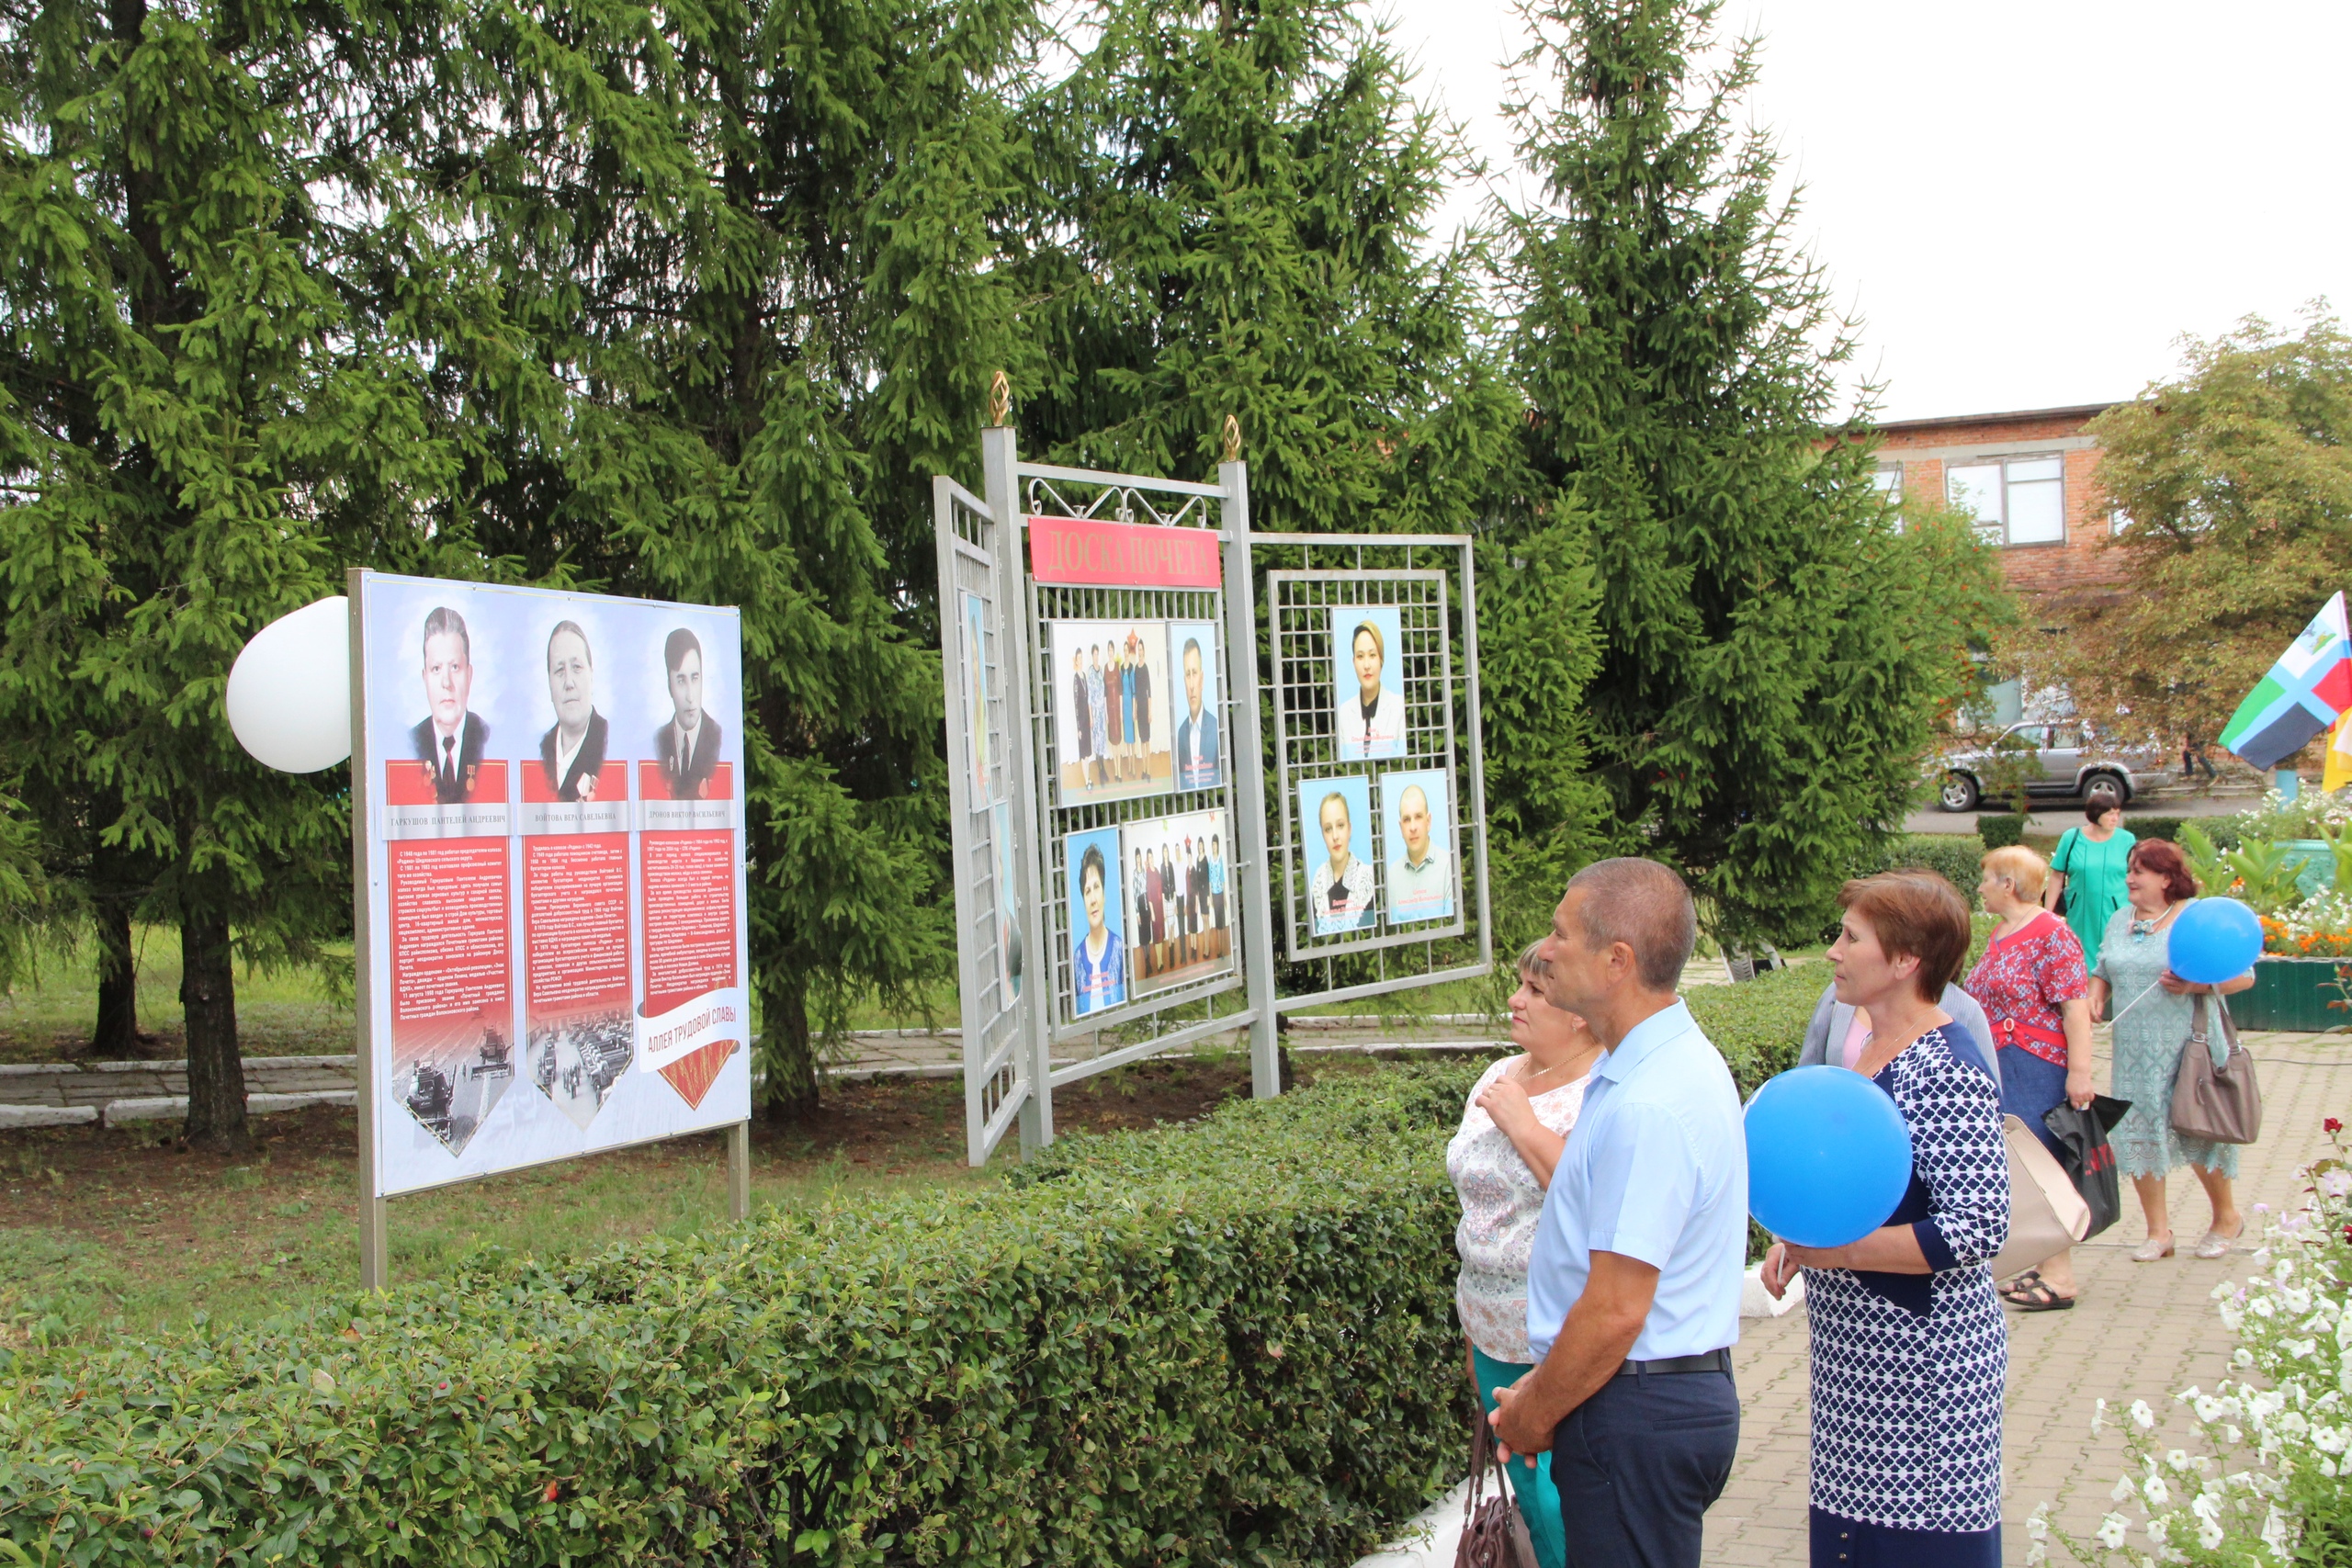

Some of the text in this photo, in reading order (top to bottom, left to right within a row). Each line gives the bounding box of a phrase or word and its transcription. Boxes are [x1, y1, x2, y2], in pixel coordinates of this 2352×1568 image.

[1047, 530, 1209, 577] ДОСКА ПОЧЕТА
[390, 814, 506, 827] ГАРКУШОВ ПАНТЕЛЕЙ АНДРЕЕВИЧ
[535, 813, 563, 822] ВОЙТОВА
[579, 812, 616, 821] САВЕЛЬЕВНА
[648, 1006, 736, 1053] АЛЛЕЯ ТРУДОВОЙ СЛАВЫ
